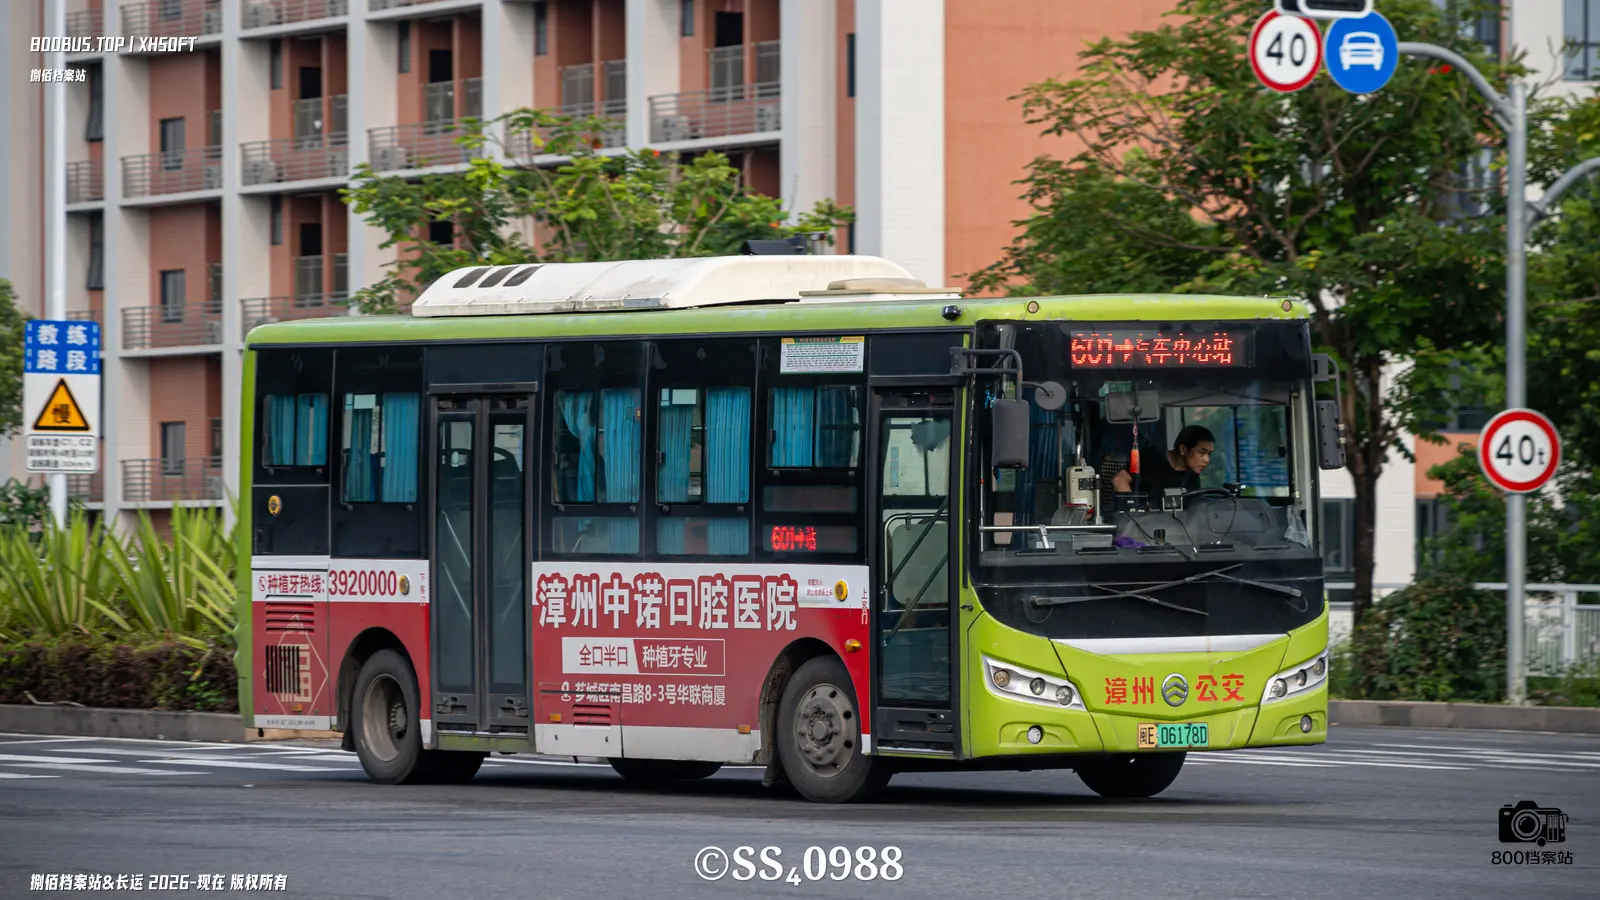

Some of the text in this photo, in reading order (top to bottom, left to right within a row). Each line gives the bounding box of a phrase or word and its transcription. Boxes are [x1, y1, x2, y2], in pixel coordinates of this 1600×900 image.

[1266, 32, 1307, 67] 40
[37, 324, 88, 345] 教练
[36, 349, 87, 371] 路段
[1071, 333, 1112, 364] 601
[52, 403, 71, 424] 慢
[1496, 434, 1544, 465] 40t
[771, 526, 795, 551] 601
[328, 570, 397, 596] 3920000
[538, 578, 798, 631] 漳州中诺口腔医院
[579, 644, 628, 667] 全口半口
[642, 645, 708, 668] 种植牙专业
[1105, 673, 1245, 705] 漳州 公交
[1161, 726, 1207, 744] 06178D
